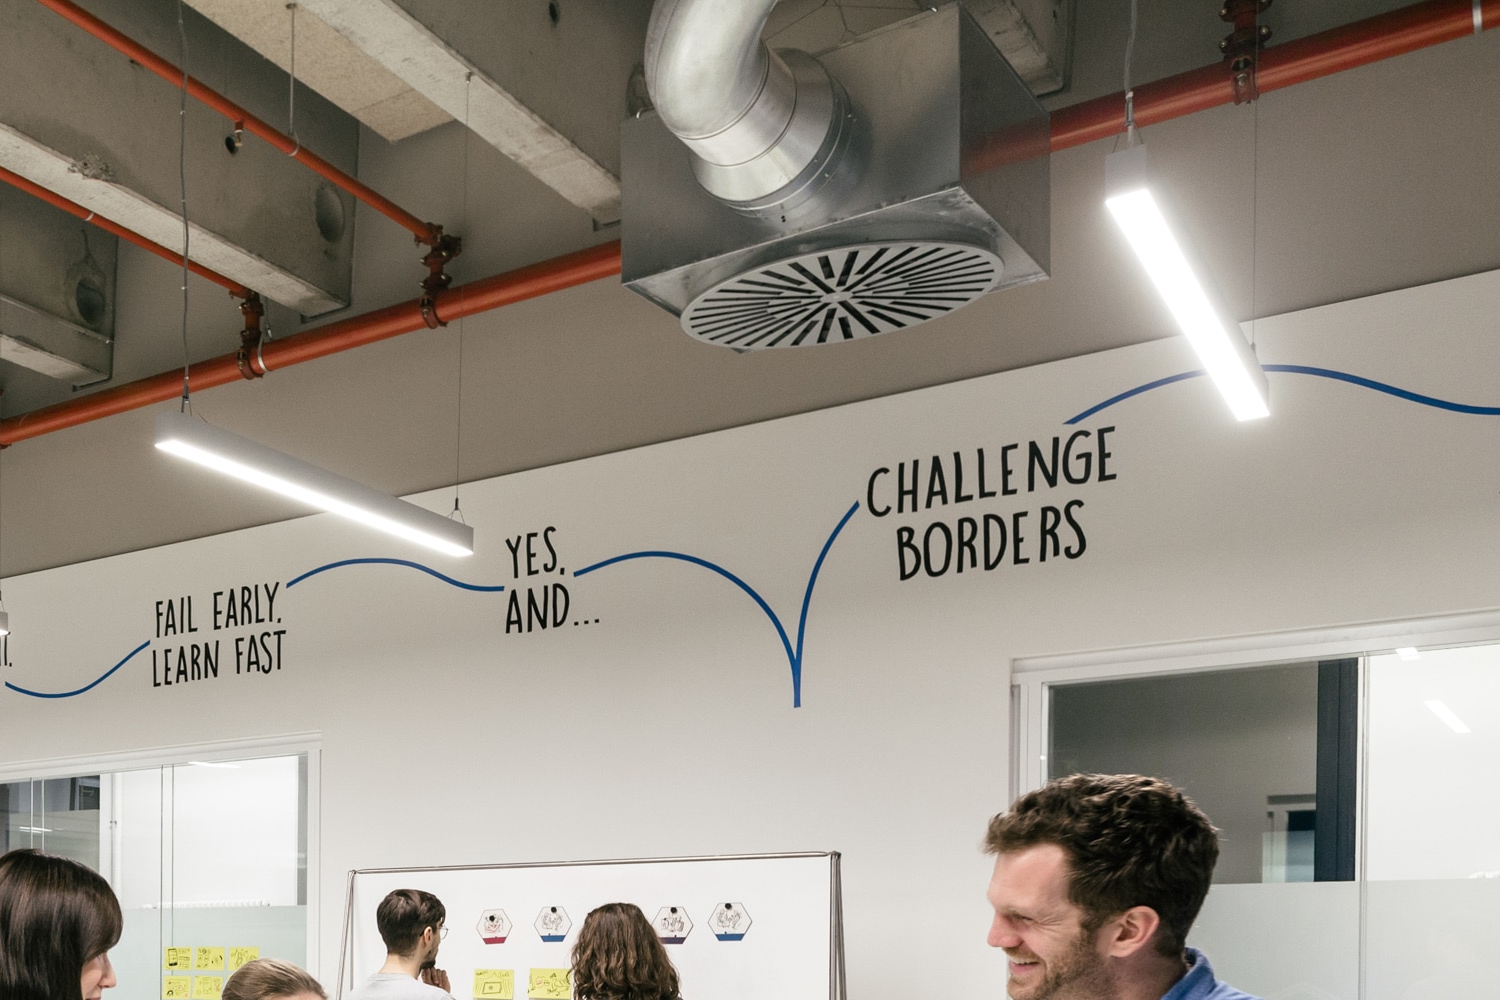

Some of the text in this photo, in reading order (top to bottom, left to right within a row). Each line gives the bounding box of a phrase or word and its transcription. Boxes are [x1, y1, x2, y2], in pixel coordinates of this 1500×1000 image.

[867, 426, 1117, 517] CHALLENGE
[897, 499, 1087, 581] BORDERS
[155, 595, 198, 638] FAIL
[506, 583, 600, 634] AND...
[152, 630, 286, 687] LEARN FAST
